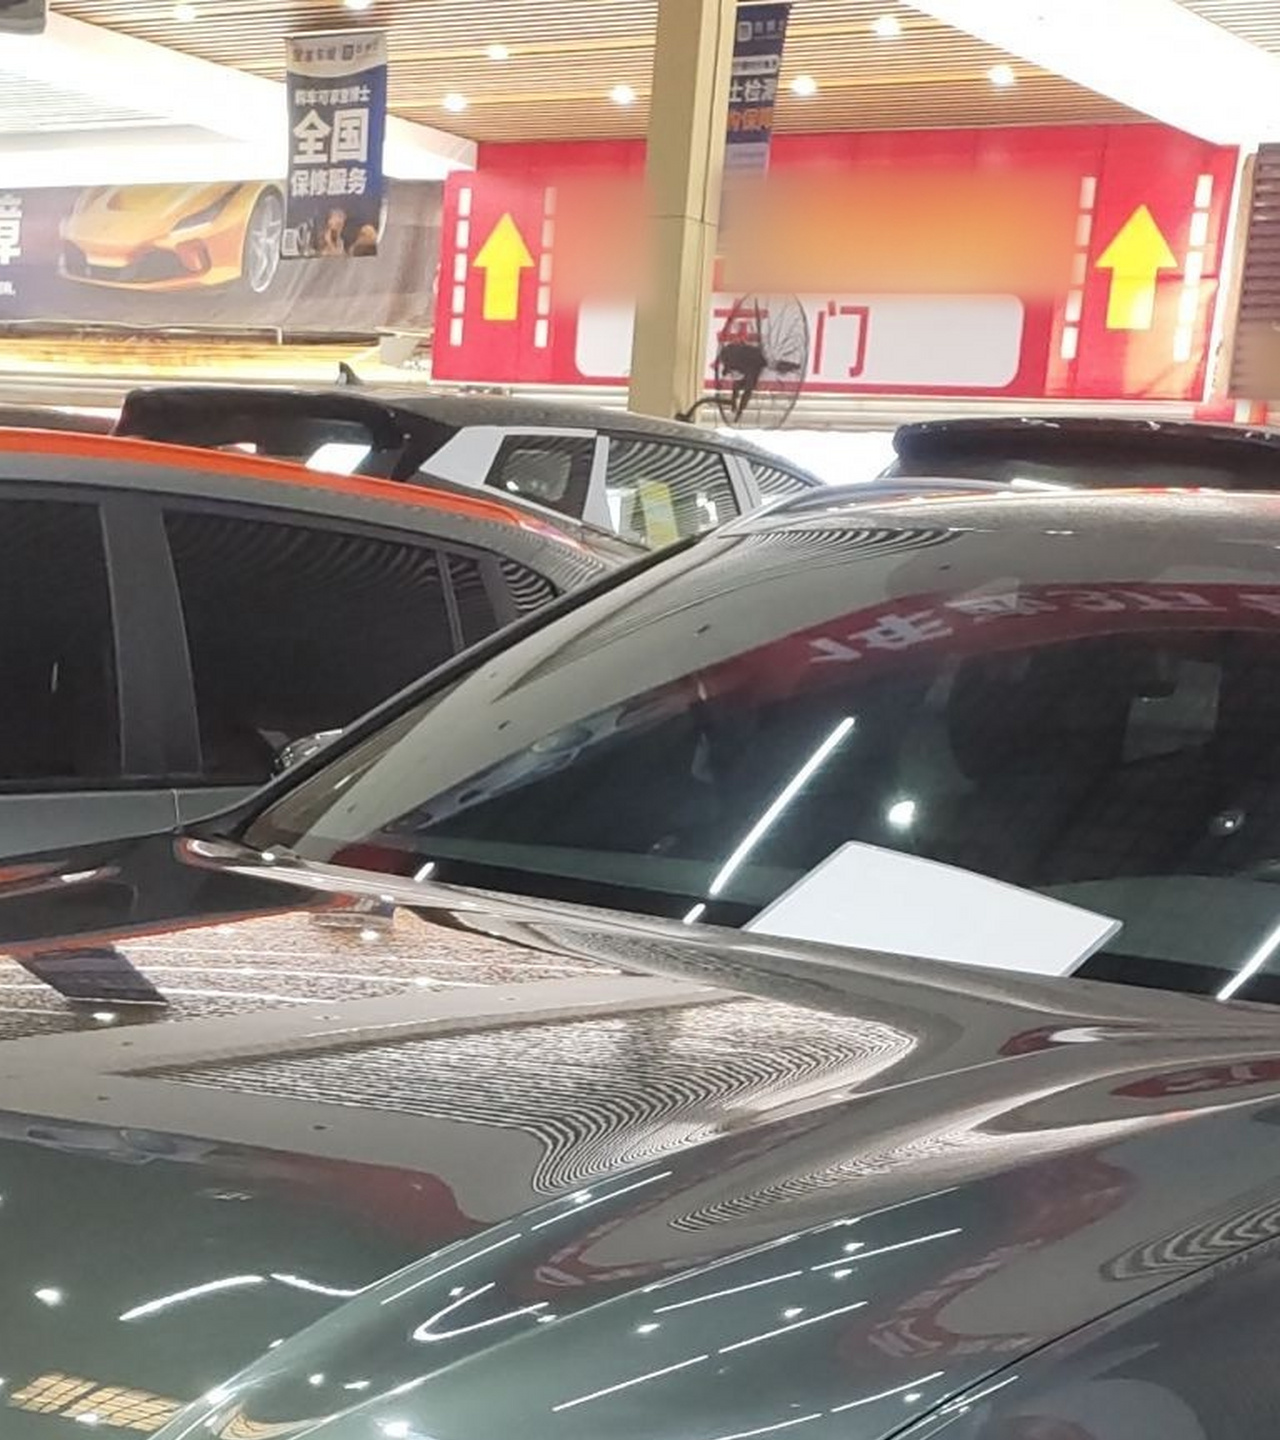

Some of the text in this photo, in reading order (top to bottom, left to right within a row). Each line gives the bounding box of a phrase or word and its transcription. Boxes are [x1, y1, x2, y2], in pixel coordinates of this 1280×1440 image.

[293, 108, 370, 163] 全国
[291, 167, 368, 197] 保修服务
